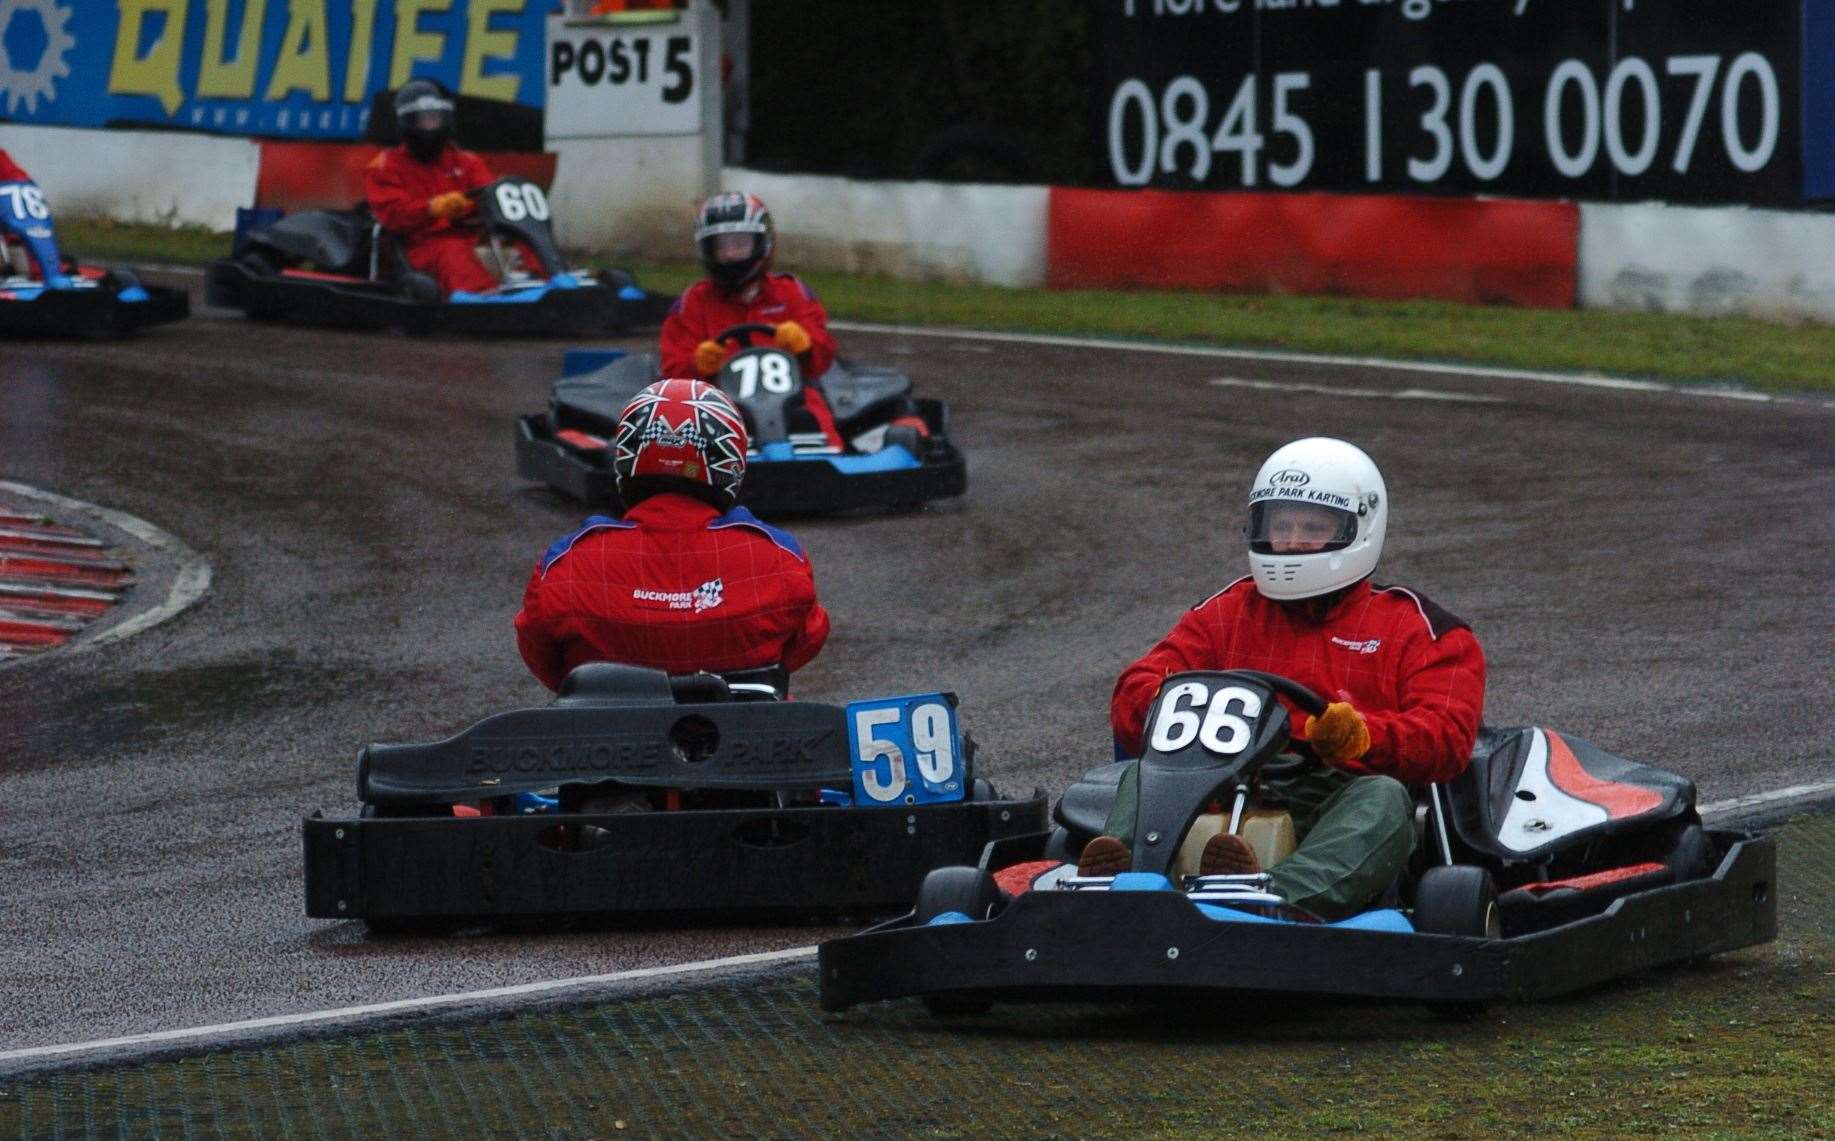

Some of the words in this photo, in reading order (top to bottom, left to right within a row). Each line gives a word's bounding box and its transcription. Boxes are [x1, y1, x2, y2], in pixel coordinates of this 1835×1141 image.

[107, 0, 527, 117] QUAIFE
[551, 37, 651, 86] POST
[661, 37, 693, 104] 5
[1109, 73, 1314, 186] 0845
[1366, 63, 1514, 182] 130
[1544, 52, 1780, 178] 0070
[495, 182, 549, 222] 60
[730, 353, 792, 399] 78
[1278, 488, 1303, 498] PARK
[1308, 491, 1350, 507] KARTING
[633, 589, 692, 602] BUCKMORE
[669, 601, 692, 609] PARK
[1151, 682, 1261, 754] 66
[468, 739, 663, 773] BUCKMORE
[723, 734, 826, 769] PARK
[855, 703, 953, 802] 59
